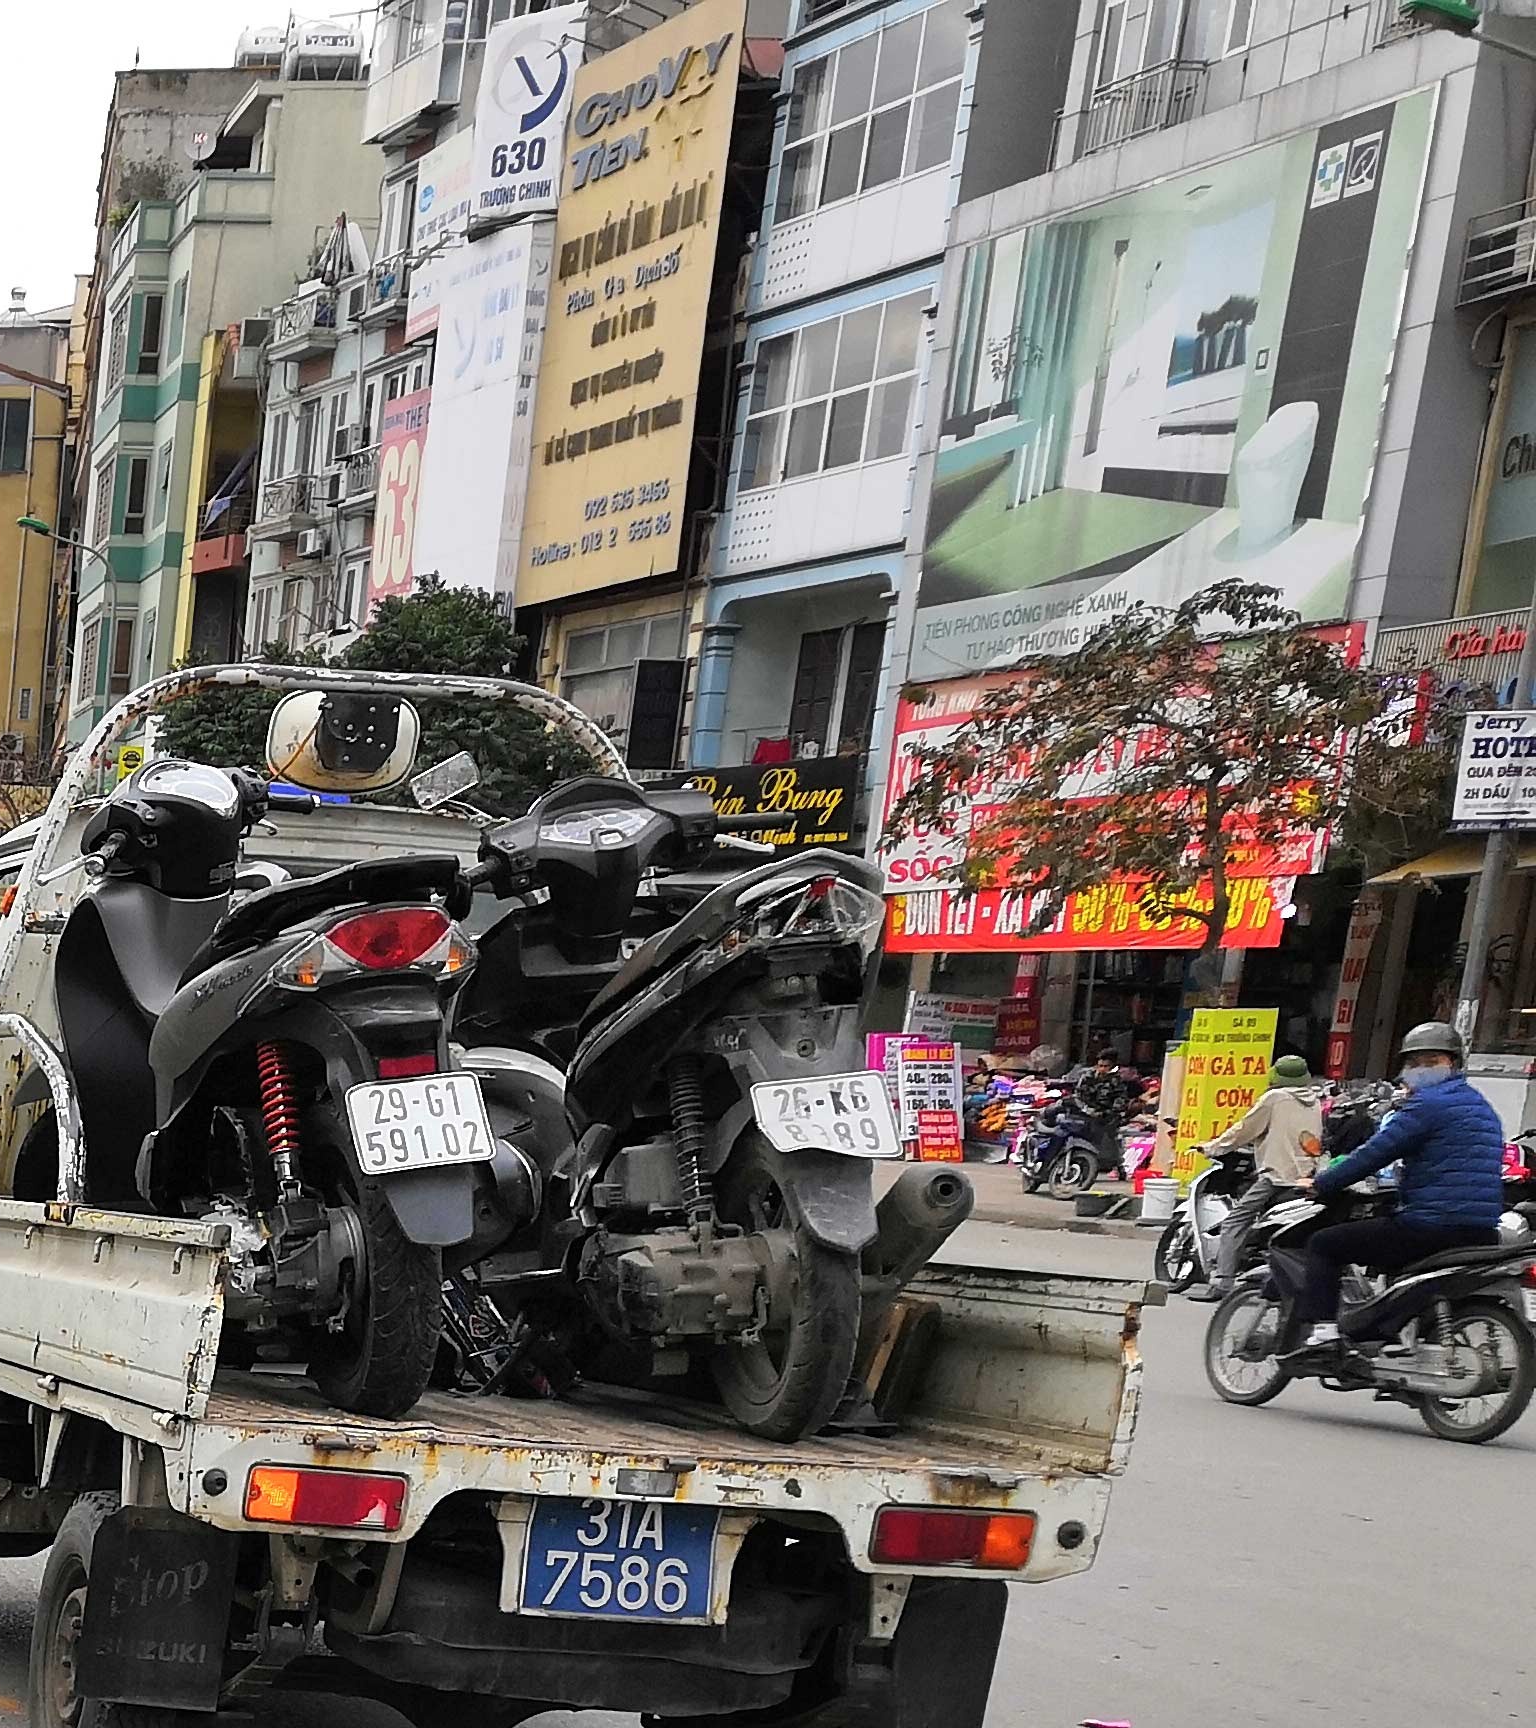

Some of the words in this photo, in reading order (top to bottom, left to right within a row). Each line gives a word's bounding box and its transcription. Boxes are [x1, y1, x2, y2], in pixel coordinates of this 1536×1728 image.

[491, 136, 546, 178] 630
[480, 183, 516, 209] TRƯỜNG
[519, 180, 552, 202] CHINH
[954, 610, 1001, 636] PHONG
[1002, 602, 1041, 627] CÔNG
[1088, 590, 1129, 613] XANH
[1475, 714, 1527, 733] Jerry
[1470, 736, 1536, 759] HOTE
[1467, 767, 1494, 779] QUA
[756, 768, 844, 826] Bung
[1463, 787, 1480, 800] 2H
[1241, 1055, 1267, 1075] TA
[373, 1081, 463, 1124] 29-G1
[1215, 1084, 1255, 1108] CƠM
[365, 1122, 480, 1166] 591.02
[577, 1499, 664, 1551] 31A
[542, 1549, 689, 1613] 7586
